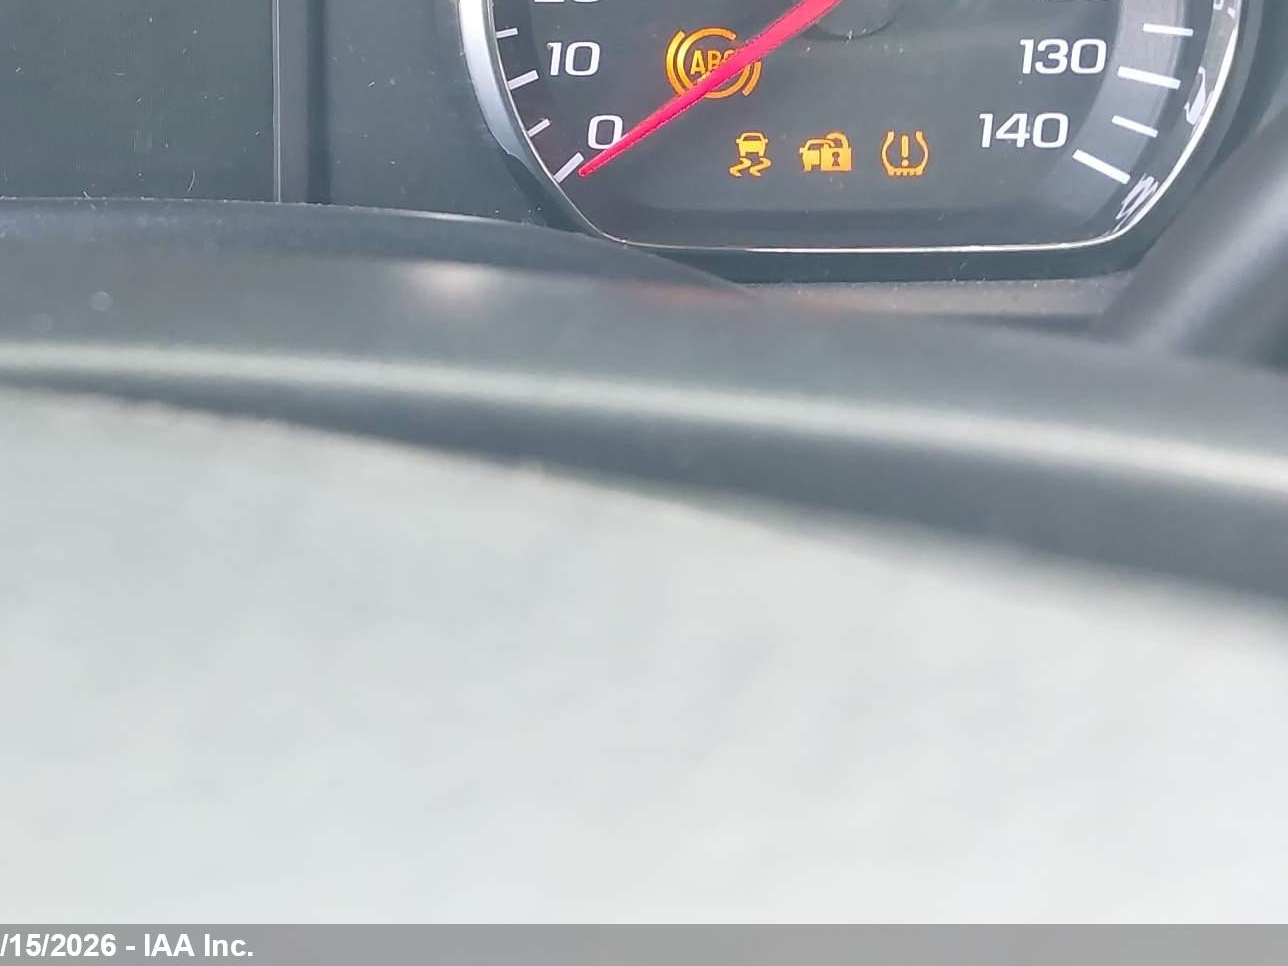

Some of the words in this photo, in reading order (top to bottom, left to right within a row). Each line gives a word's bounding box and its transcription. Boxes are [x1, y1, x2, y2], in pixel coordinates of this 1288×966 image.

[547, 40, 601, 76] 10
[690, 46, 733, 73] AB
[1019, 38, 1107, 75] 130
[587, 114, 624, 150] 0
[979, 112, 1070, 149] 140
